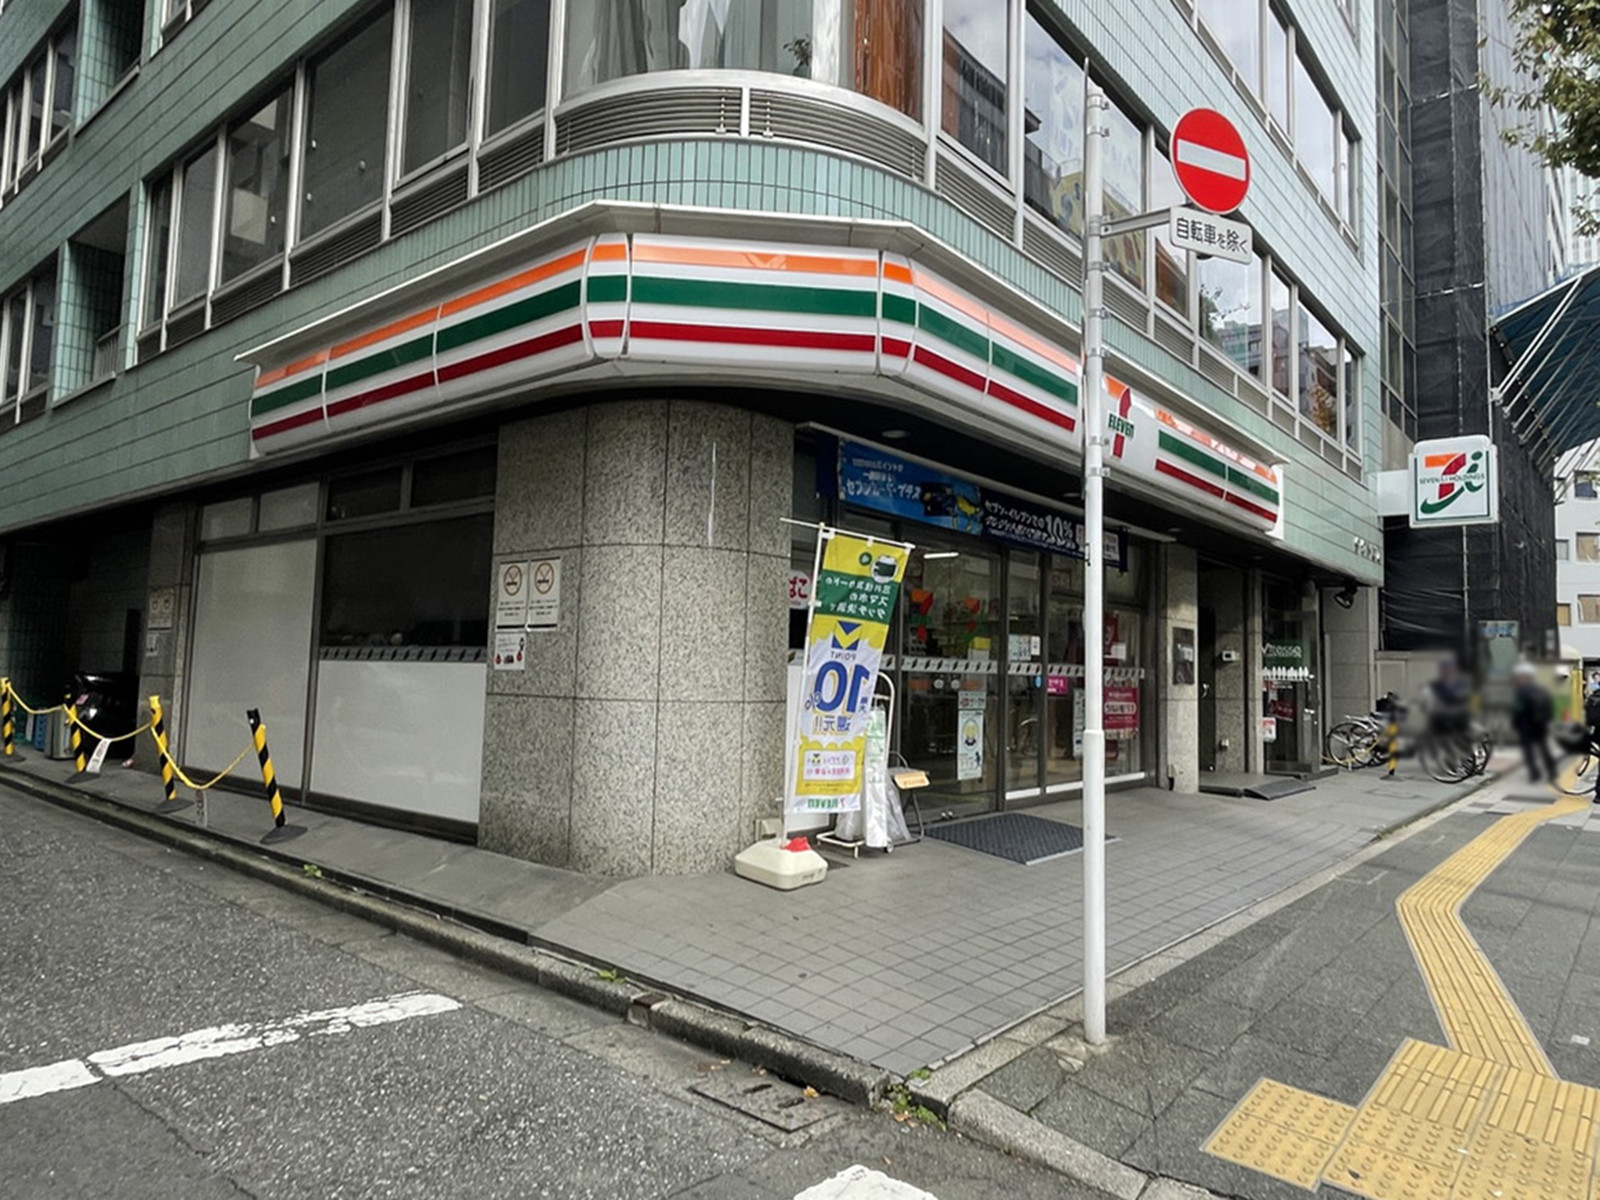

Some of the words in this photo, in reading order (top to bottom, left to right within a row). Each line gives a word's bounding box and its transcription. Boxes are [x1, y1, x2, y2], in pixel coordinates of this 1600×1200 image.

[1176, 216, 1249, 256] 自転車を除く
